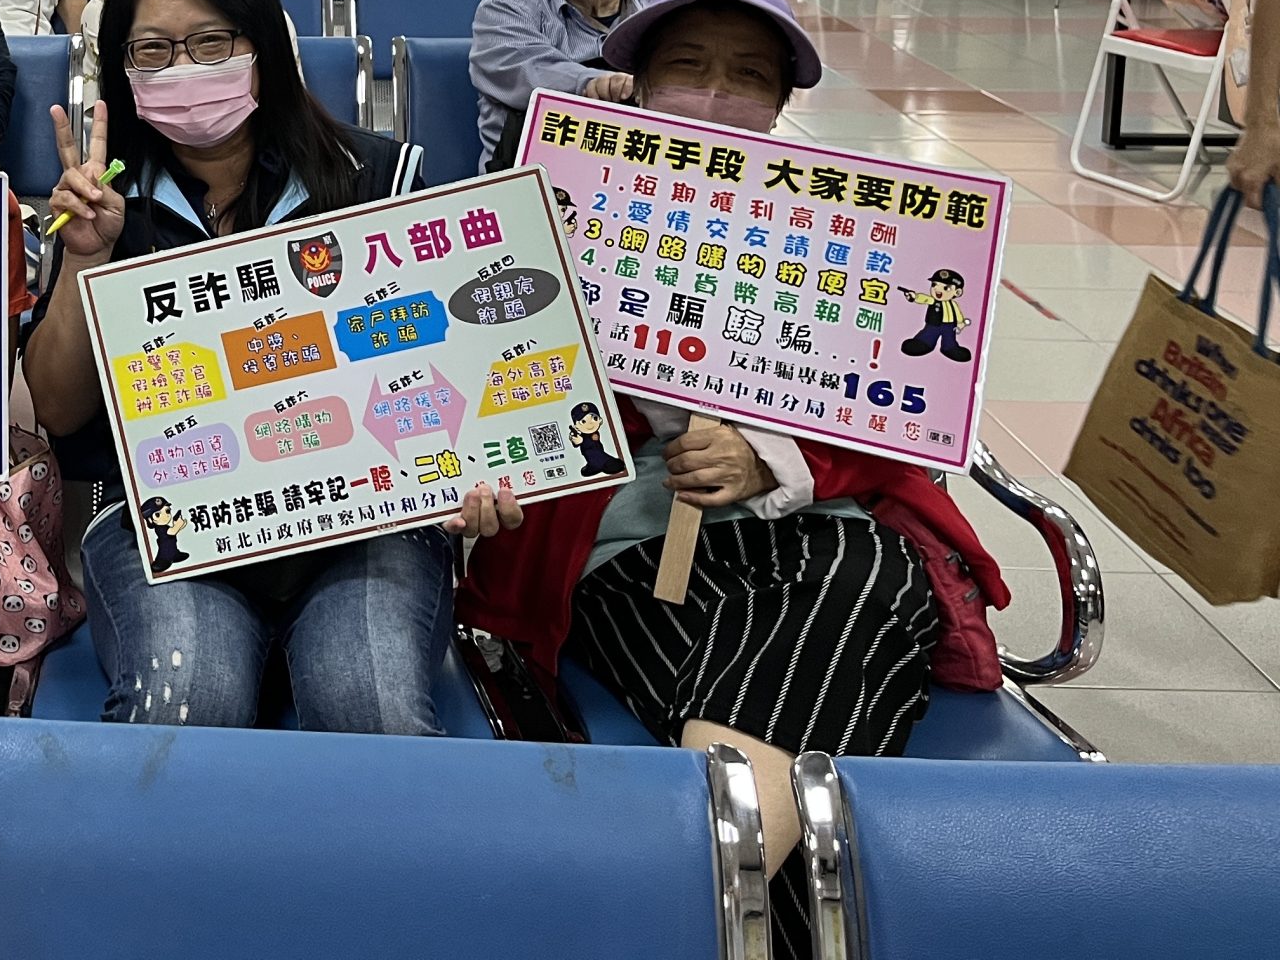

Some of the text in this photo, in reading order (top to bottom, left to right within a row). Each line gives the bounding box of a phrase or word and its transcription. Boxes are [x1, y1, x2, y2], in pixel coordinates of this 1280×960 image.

[541, 111, 988, 229] 詐騙新手段 大家要防範
[143, 208, 503, 325] 反詐騙 八部曲
[477, 255, 515, 281] 反詐四
[306, 272, 337, 289] POLICE
[363, 281, 400, 306] 反詐三
[472, 276, 535, 304] 假親友
[253, 307, 287, 331] 反詐二
[347, 301, 430, 333] 家戶拜訪
[478, 300, 526, 325] 詐騙
[142, 332, 175, 354] 反詐一
[247, 332, 299, 353] 中獎、
[371, 324, 418, 349] 詐騙
[128, 350, 196, 373] 假警察、
[242, 344, 322, 374] 投資詐騙
[501, 339, 537, 362] 反詐八
[132, 365, 205, 391] 假檢察官
[389, 370, 424, 393] 反詐七
[486, 356, 565, 387] 海外高薪
[136, 382, 212, 413] 辦案詐騙
[274, 391, 309, 413] 反詐六
[373, 388, 451, 417] 網路援交
[492, 376, 573, 406] 求職詐騙
[600, 350, 921, 441] 政府警察局中和分局提醒您
[163, 415, 198, 439] 反詐五
[255, 410, 332, 438] 網路購物
[396, 411, 441, 433] 詐騙
[148, 435, 223, 464] 購物個資
[277, 432, 321, 455] 詐騙
[929, 432, 953, 444] 廣告
[152, 453, 230, 483] 外洩詐騙
[188, 490, 278, 533] 預防詐騙
[215, 471, 536, 554] 新北市政府警察局中和分局 醒您
